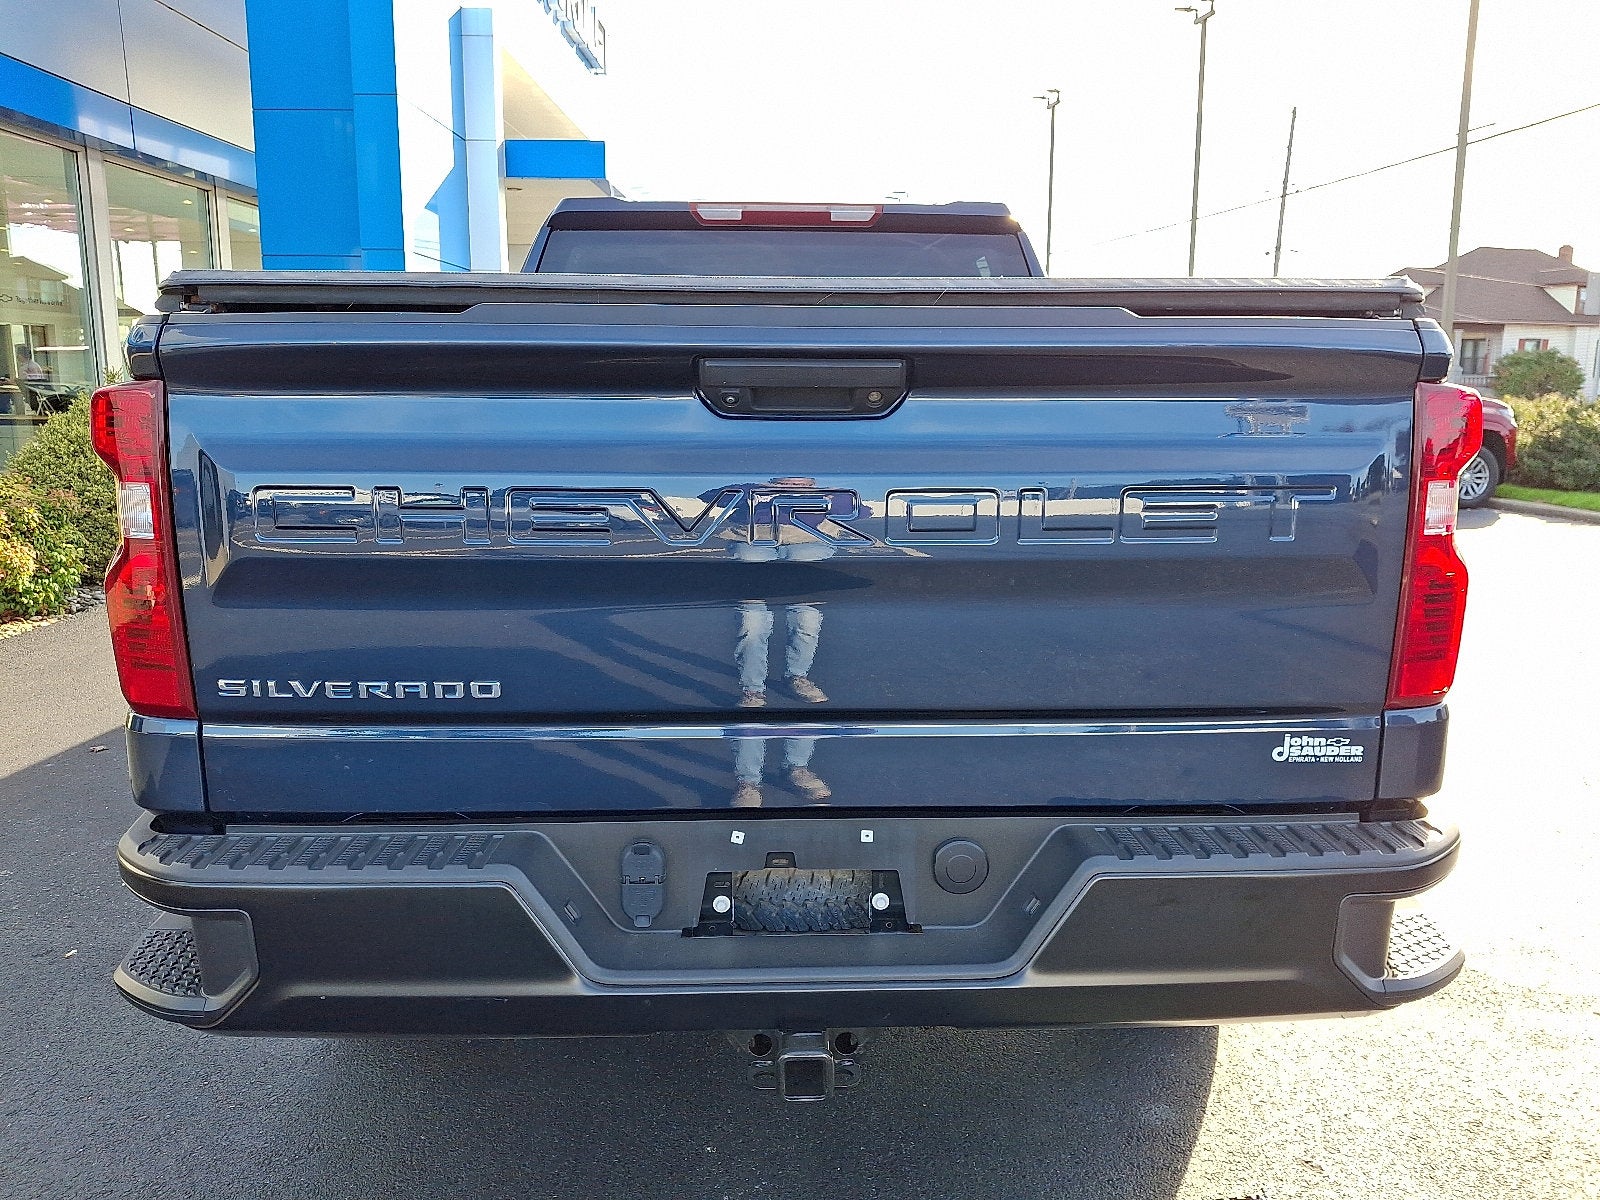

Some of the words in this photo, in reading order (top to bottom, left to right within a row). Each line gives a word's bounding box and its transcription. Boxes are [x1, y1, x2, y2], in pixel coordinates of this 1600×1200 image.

[251, 484, 1338, 547] CHEVROLET
[217, 678, 501, 699] SILVERADO
[1290, 746, 1363, 756] SAUDER
